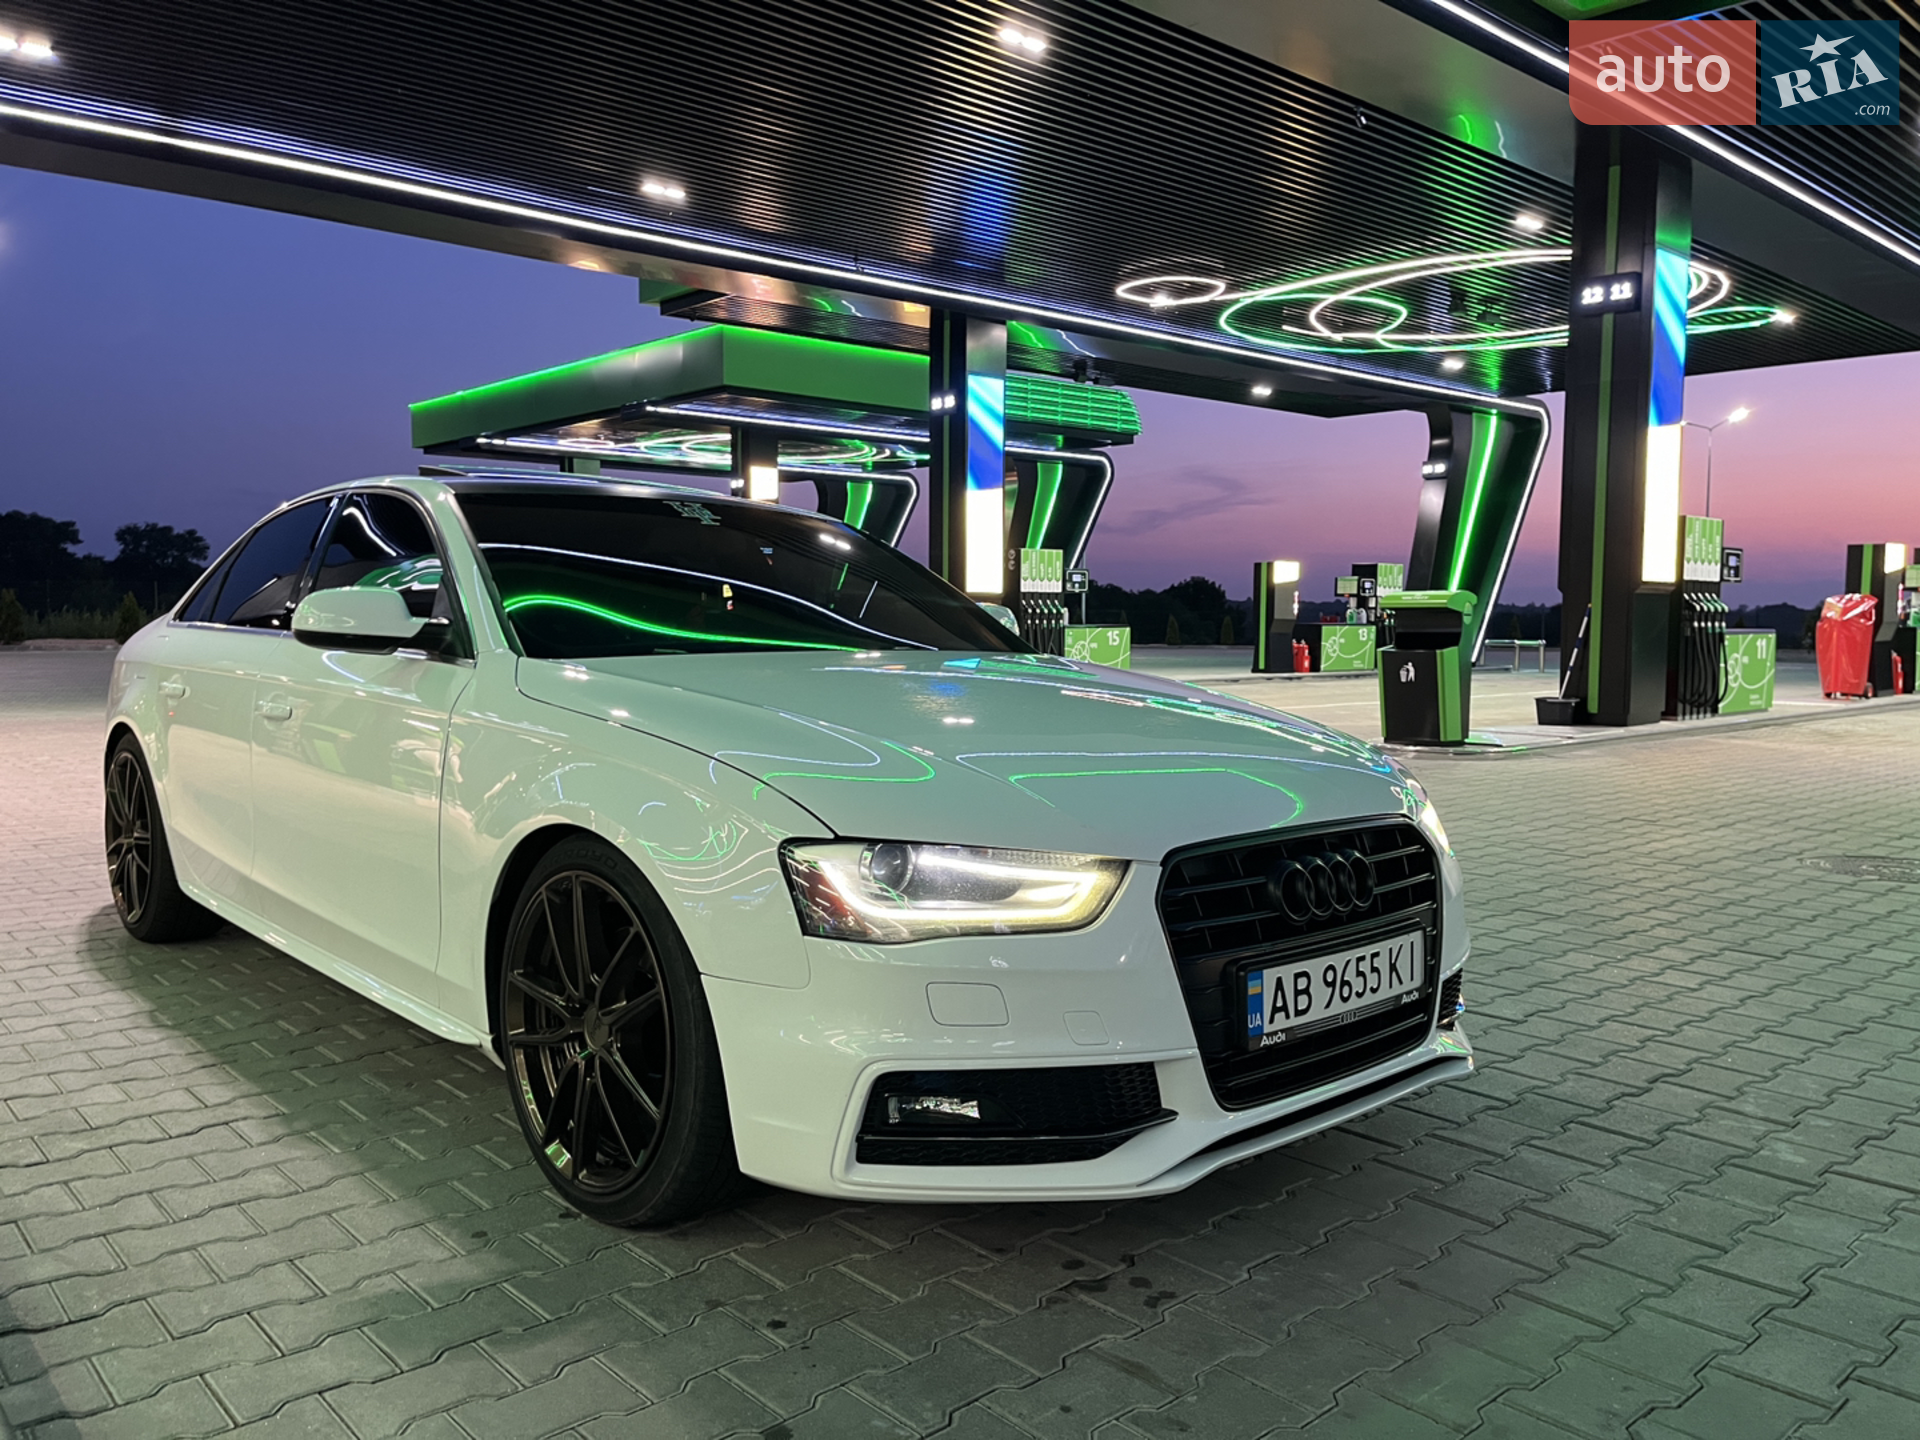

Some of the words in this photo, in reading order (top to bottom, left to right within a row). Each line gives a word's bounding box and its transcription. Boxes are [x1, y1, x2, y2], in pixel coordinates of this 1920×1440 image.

[1581, 286, 1604, 305] 12
[1609, 281, 1633, 301] 11
[1106, 630, 1120, 646] 15
[1358, 627, 1368, 641] 13
[1755, 637, 1767, 660] 11
[1268, 970, 1313, 1024] AB
[1323, 950, 1381, 1010] 9655
[1389, 940, 1414, 989] KI
[1401, 990, 1419, 1004] Audi
[1248, 1013, 1262, 1028] UA
[1260, 1032, 1286, 1047] Audi
